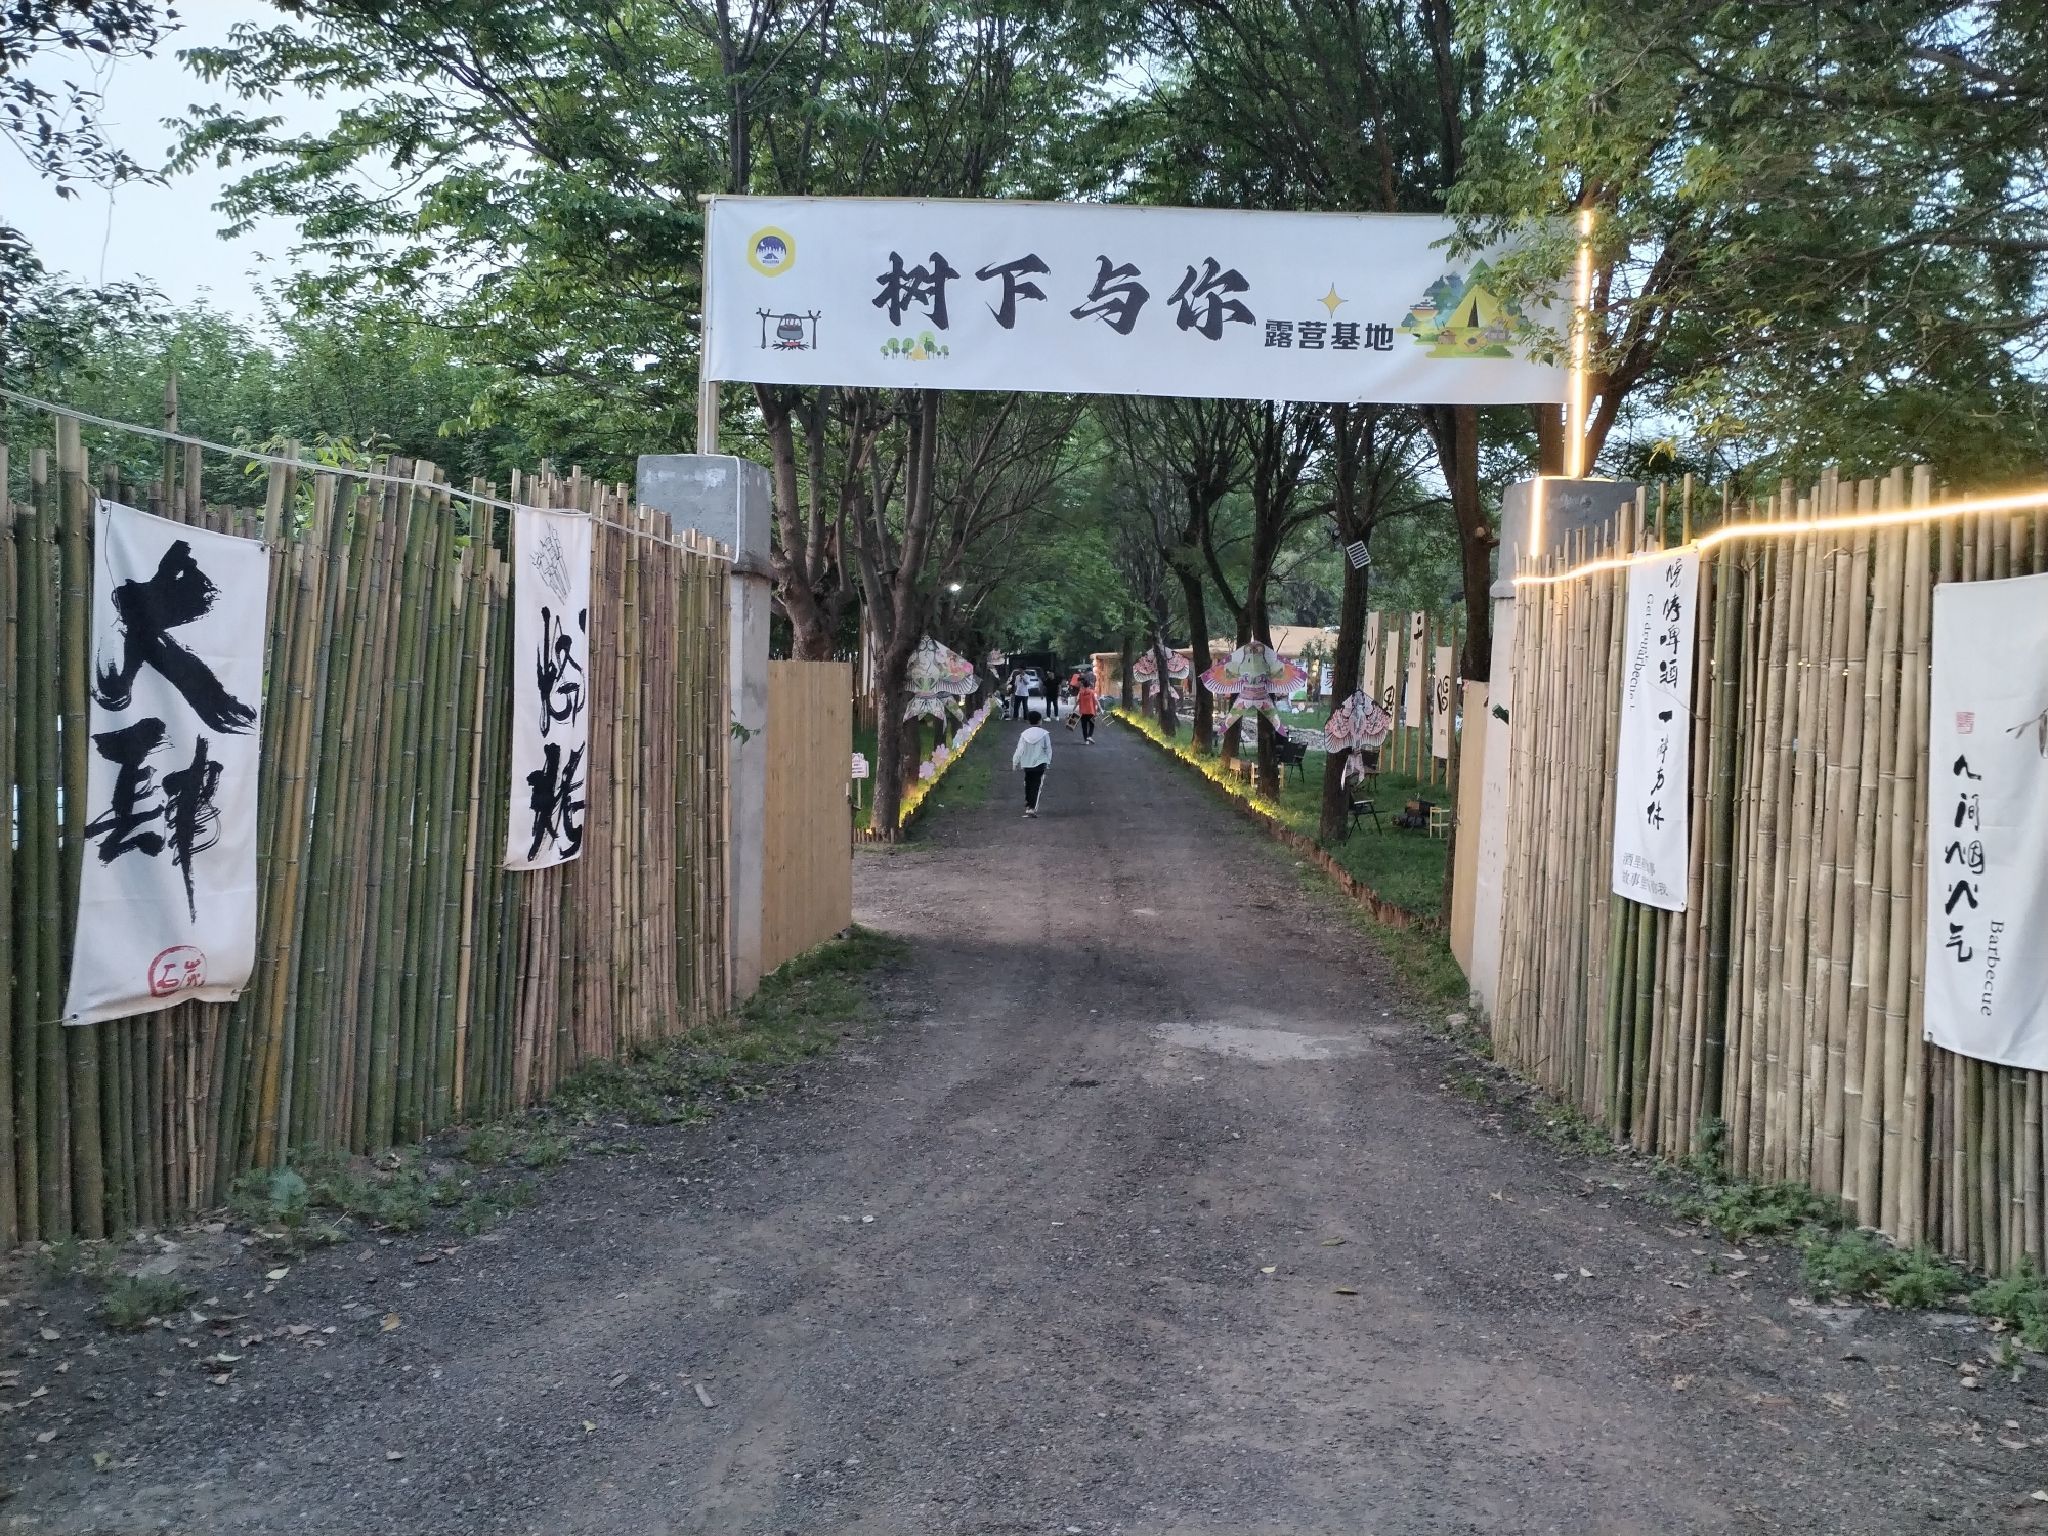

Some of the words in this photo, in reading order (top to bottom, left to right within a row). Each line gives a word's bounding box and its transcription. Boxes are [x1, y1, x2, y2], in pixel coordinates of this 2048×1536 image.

[872, 251, 1256, 341] 树下与你
[1263, 318, 1395, 352] 露营基地
[1945, 753, 1986, 963] 人间烟火气
[1980, 920, 2005, 1017] Barbecue
